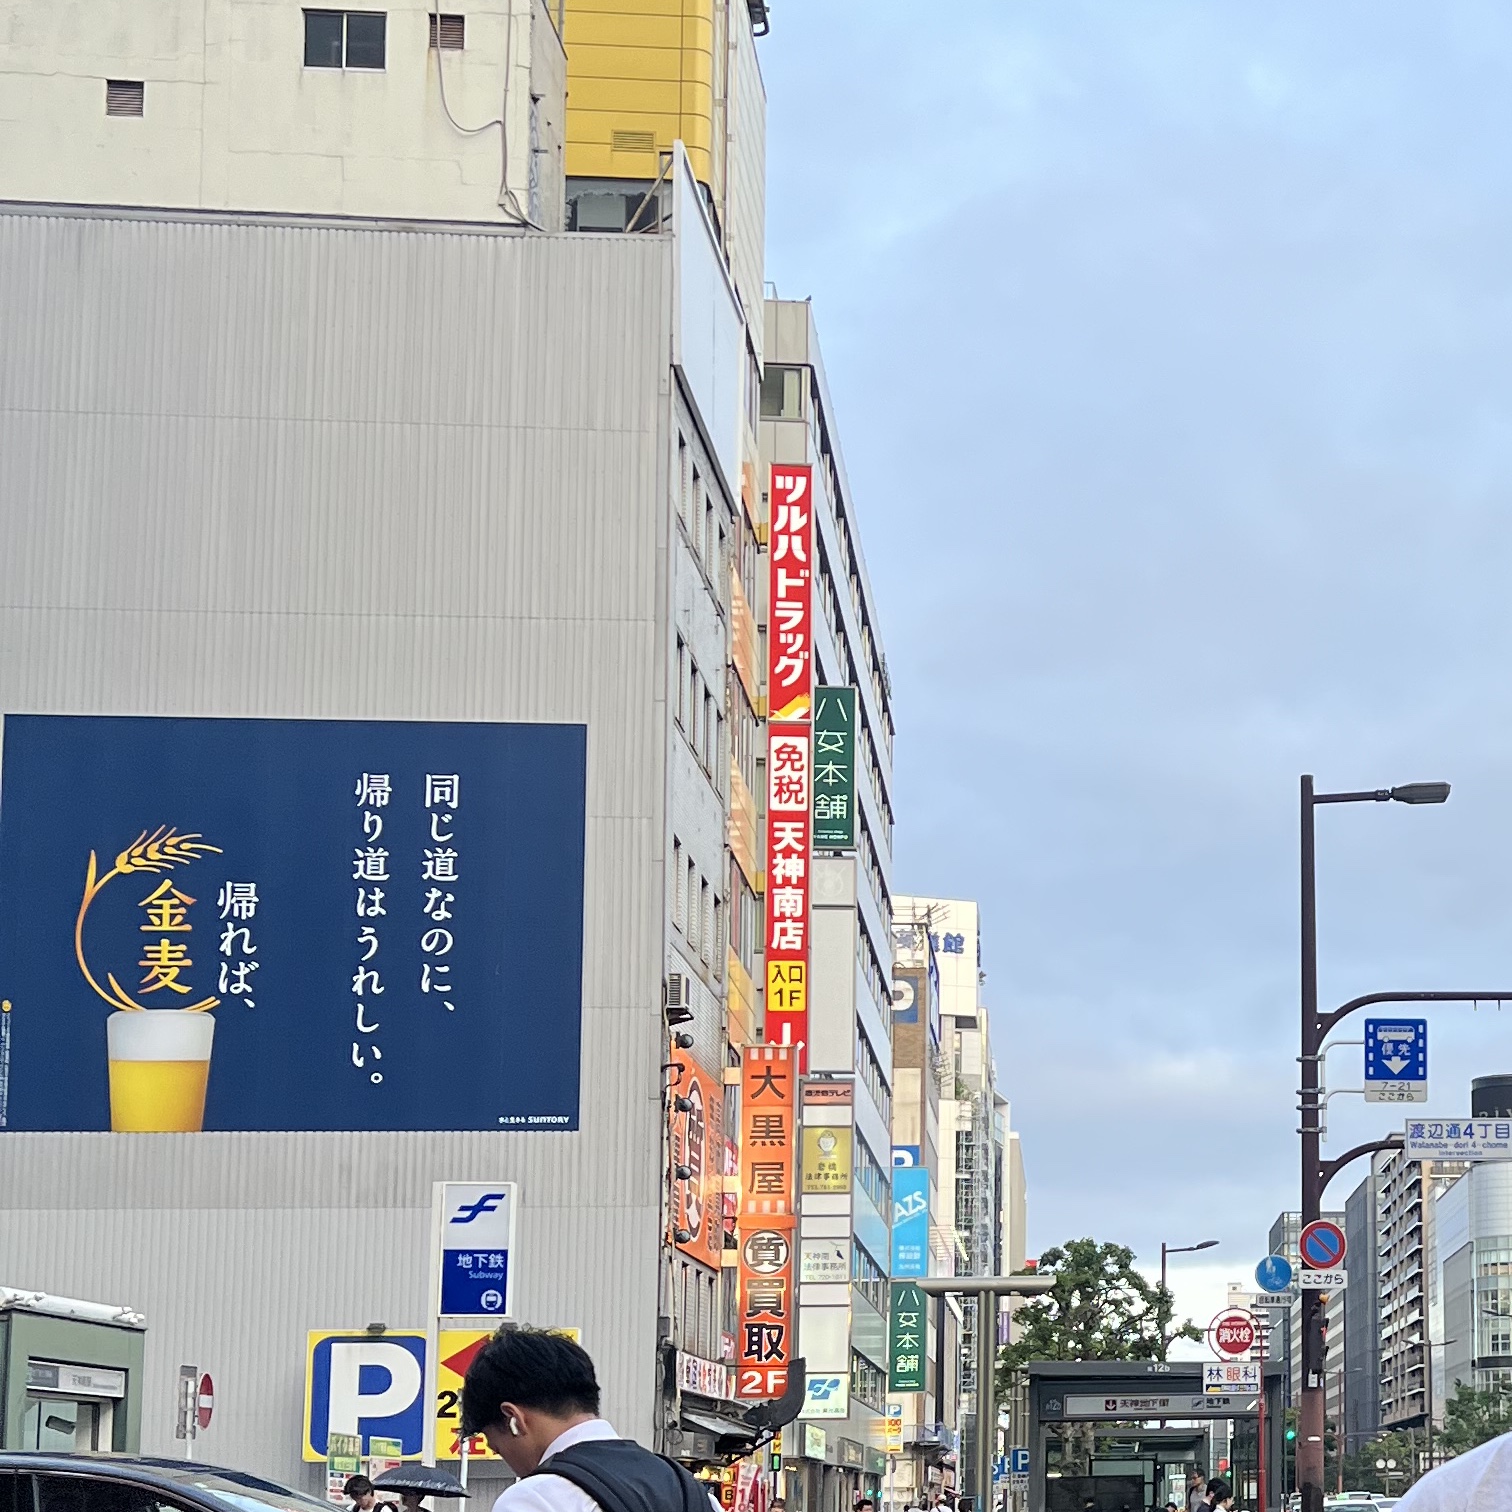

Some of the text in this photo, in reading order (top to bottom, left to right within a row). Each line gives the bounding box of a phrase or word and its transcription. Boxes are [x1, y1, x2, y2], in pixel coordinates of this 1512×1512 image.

[773, 475, 810, 688] ツルハドラッグ
[814, 697, 848, 820] 八女本舗
[773, 742, 804, 805] 免税
[421, 773, 460, 1012] 同じ道なのに、
[771, 822, 805, 951] 天神南店
[138, 878, 197, 995] 金麦
[352, 773, 392, 1085] 帰り道はうれしい。
[217, 881, 259, 1009] 帰れば、
[772, 965, 803, 984] 入口
[773, 990, 802, 1008] 1F
[1382, 1043, 1411, 1056] 優先
[1382, 1082, 1411, 1090] 7-21
[1379, 1093, 1414, 1101] ここから
[527, 1116, 570, 1124] SUNTORY
[750, 1065, 787, 1195] 大黒屋
[1409, 1123, 1510, 1139] 渡辺通4丁目
[894, 1190, 927, 1222] AZS
[457, 1253, 504, 1269] 地下鉄
[468, 1270, 503, 1280] Subway
[1302, 1274, 1344, 1285] ここから
[896, 1290, 919, 1372] 八女本舗
[1219, 1328, 1251, 1343] 消火栓
[741, 1370, 787, 1394] 2F
[1207, 1366, 1257, 1382] 林眼科
[328, 1342, 421, 1437] P
[1018, 1451, 1029, 1470] P
